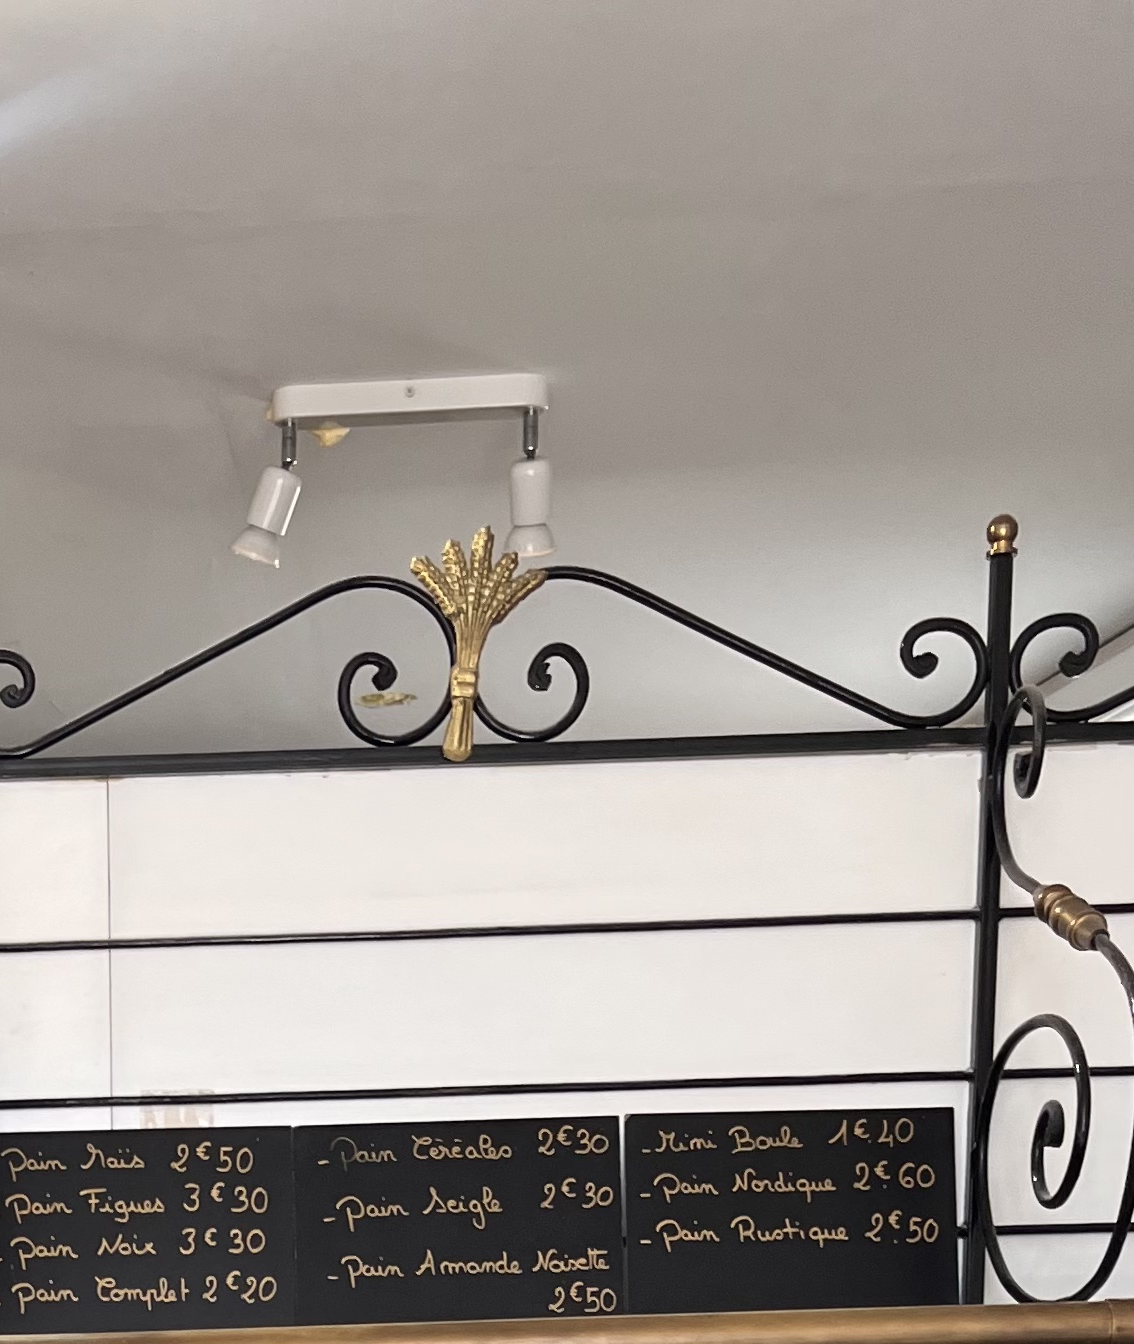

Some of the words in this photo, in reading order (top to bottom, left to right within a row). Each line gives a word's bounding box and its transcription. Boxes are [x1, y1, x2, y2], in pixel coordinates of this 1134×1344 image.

[411, 1135, 512, 1160] Céréales
[729, 1126, 803, 1154] Boule
[1, 1147, 67, 1182] Pain
[653, 1173, 719, 1203] Pain
[732, 1168, 836, 1202] Nordique
[5, 1193, 72, 1223] Pain
[79, 1188, 165, 1223] Figues
[336, 1196, 409, 1232] Pain
[422, 1187, 503, 1229] Seigle
[656, 1219, 719, 1252] Pain
[730, 1215, 848, 1248] Rustique
[10, 1236, 78, 1270] Pain
[97, 1234, 157, 1255] Noix
[342, 1255, 404, 1288] Pain
[416, 1249, 522, 1275] Amande
[532, 1247, 609, 1272] Noisette
[12, 1280, 78, 1314] Pain
[95, 1276, 189, 1310] Complet
